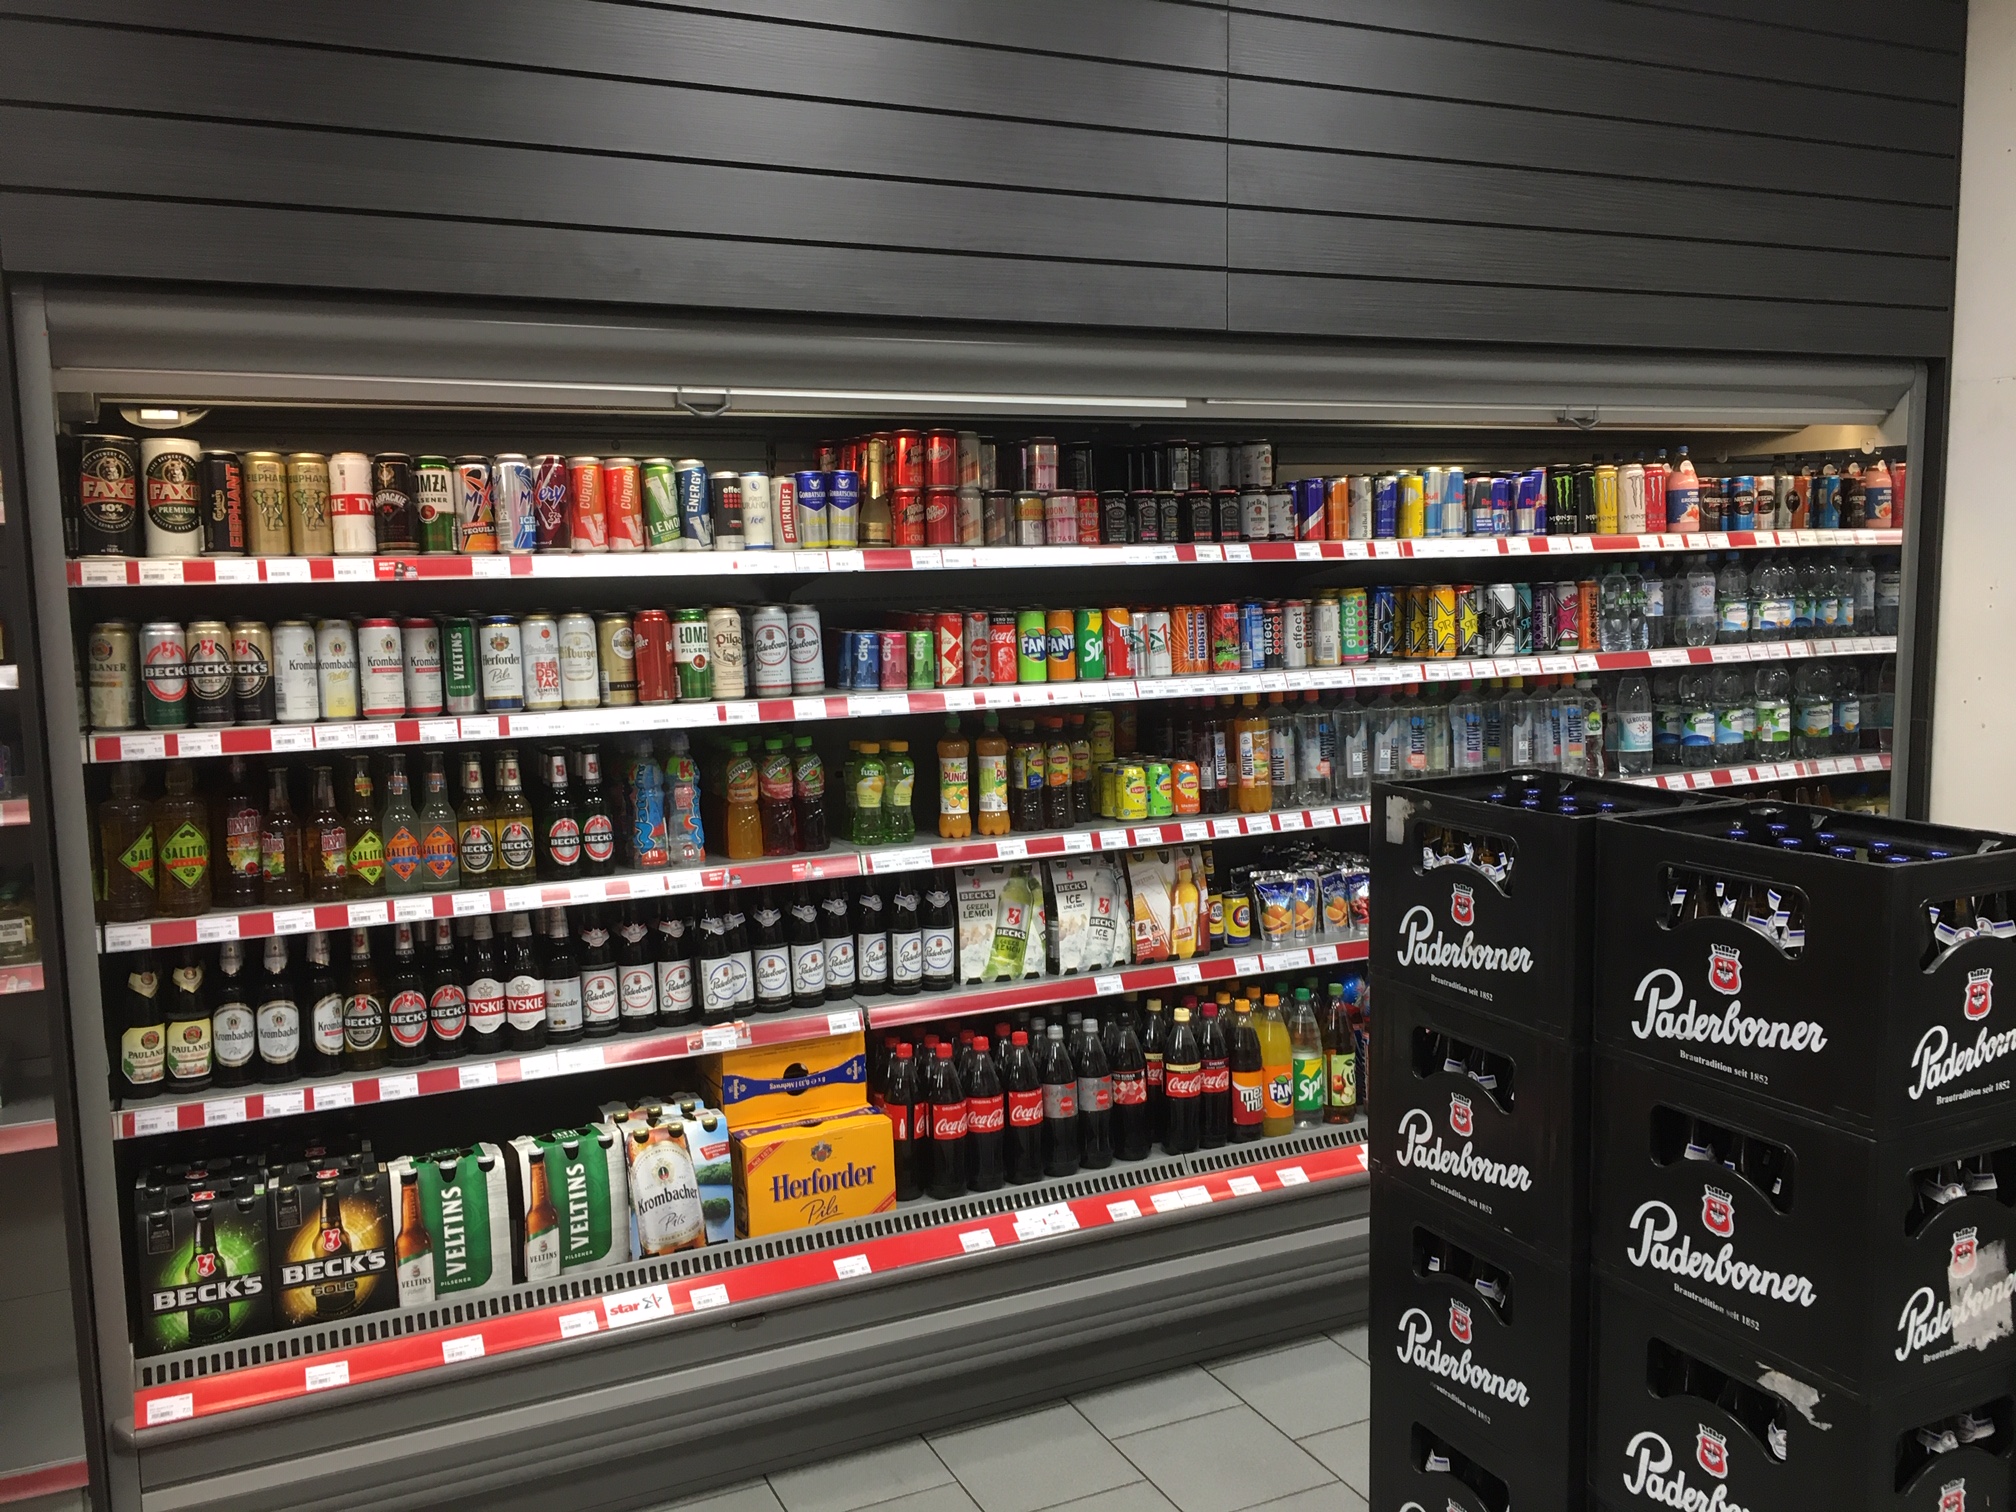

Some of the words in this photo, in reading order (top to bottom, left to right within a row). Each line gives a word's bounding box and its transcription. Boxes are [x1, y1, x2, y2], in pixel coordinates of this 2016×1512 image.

[82, 481, 135, 498] FAXE
[579, 469, 595, 510] CURUBA
[620, 469, 635, 510] CURUBA
[686, 469, 702, 513] ENERGY
[100, 503, 124, 513] 10%
[158, 506, 196, 514] PREMIUM
[225, 463, 244, 548] ELEPHANT
[785, 487, 796, 540] SMIRNOFF
[1292, 611, 1303, 649] effect
[1343, 595, 1357, 648] effect
[1197, 612, 1206, 660] BOOSTER
[1264, 617, 1273, 656] effect
[453, 631, 463, 681] VELTINS
[187, 662, 232, 675] BECK'S
[489, 668, 514, 682] Pils
[536, 669, 559, 679] DEN
[536, 678, 559, 688] TAG
[1411, 726, 1425, 755] ACTIVE
[1466, 721, 1480, 752] ACTIVE
[1568, 715, 1582, 743] ACTIVE
[1242, 755, 1253, 780] ACTIVE
[462, 843, 494, 854] BECK'S
[501, 840, 533, 851] BECK'S
[550, 836, 580, 846] BECK'S
[584, 833, 613, 843] BECK'S
[961, 890, 995, 900] BECK'S
[1057, 881, 1087, 892] BECK'S
[1066, 894, 1081, 904] ICE
[963, 909, 993, 919] LEMON
[1090, 919, 1115, 928] BECK'S
[996, 929, 1026, 940] BECK'S
[1095, 928, 1108, 938] ICE
[1397, 905, 1534, 974] Paderborner
[1430, 973, 1468, 994] Brautradition
[1468, 986, 1480, 997] seit
[1479, 990, 1494, 1002] 1852
[431, 1004, 467, 1018] BECK'S
[469, 1000, 504, 1013] TYSKIE
[507, 997, 544, 1010] TYSKIE
[1631, 968, 1829, 1054] Paderborner
[345, 1014, 382, 1027] BECK'S
[391, 1011, 428, 1025] BECK'S
[1679, 1048, 1733, 1075] Brautradition
[1733, 1065, 1749, 1078] seit
[1749, 1070, 1770, 1086] 1852
[1936, 1087, 1982, 1106] Brautradition
[1982, 1082, 1995, 1096] seit
[1995, 1079, 2011, 1093] 1852
[1396, 1108, 1533, 1193] Paderborner
[769, 1162, 876, 1204] Herforder
[566, 1162, 591, 1251] VELTINS
[637, 1184, 698, 1217] Krombacher
[1429, 1178, 1468, 1203] Brautradition
[1468, 1194, 1480, 1208] seit
[1479, 1202, 1494, 1215] 1852
[658, 1213, 686, 1232] Pils
[800, 1196, 844, 1226] Pils
[441, 1185, 466, 1277] VELTINS
[529, 1250, 558, 1264] VELTINS
[565, 1250, 593, 1261] PILSENER
[1626, 1200, 1818, 1308] Paderborner
[282, 1250, 387, 1287] BECK'S
[153, 1275, 263, 1312] BECK'S
[310, 1280, 358, 1297] GOLD
[401, 1275, 432, 1290] VELTINS
[440, 1276, 472, 1288] PILSENER
[610, 1300, 641, 1316] star
[1673, 1282, 1725, 1317] Brautradition
[1725, 1308, 1741, 1323] seit
[1741, 1313, 1761, 1332] 1852
[1396, 1306, 1531, 1408] Paderborner
[1467, 1403, 1479, 1418] seit
[1478, 1410, 1492, 1425] 1852
